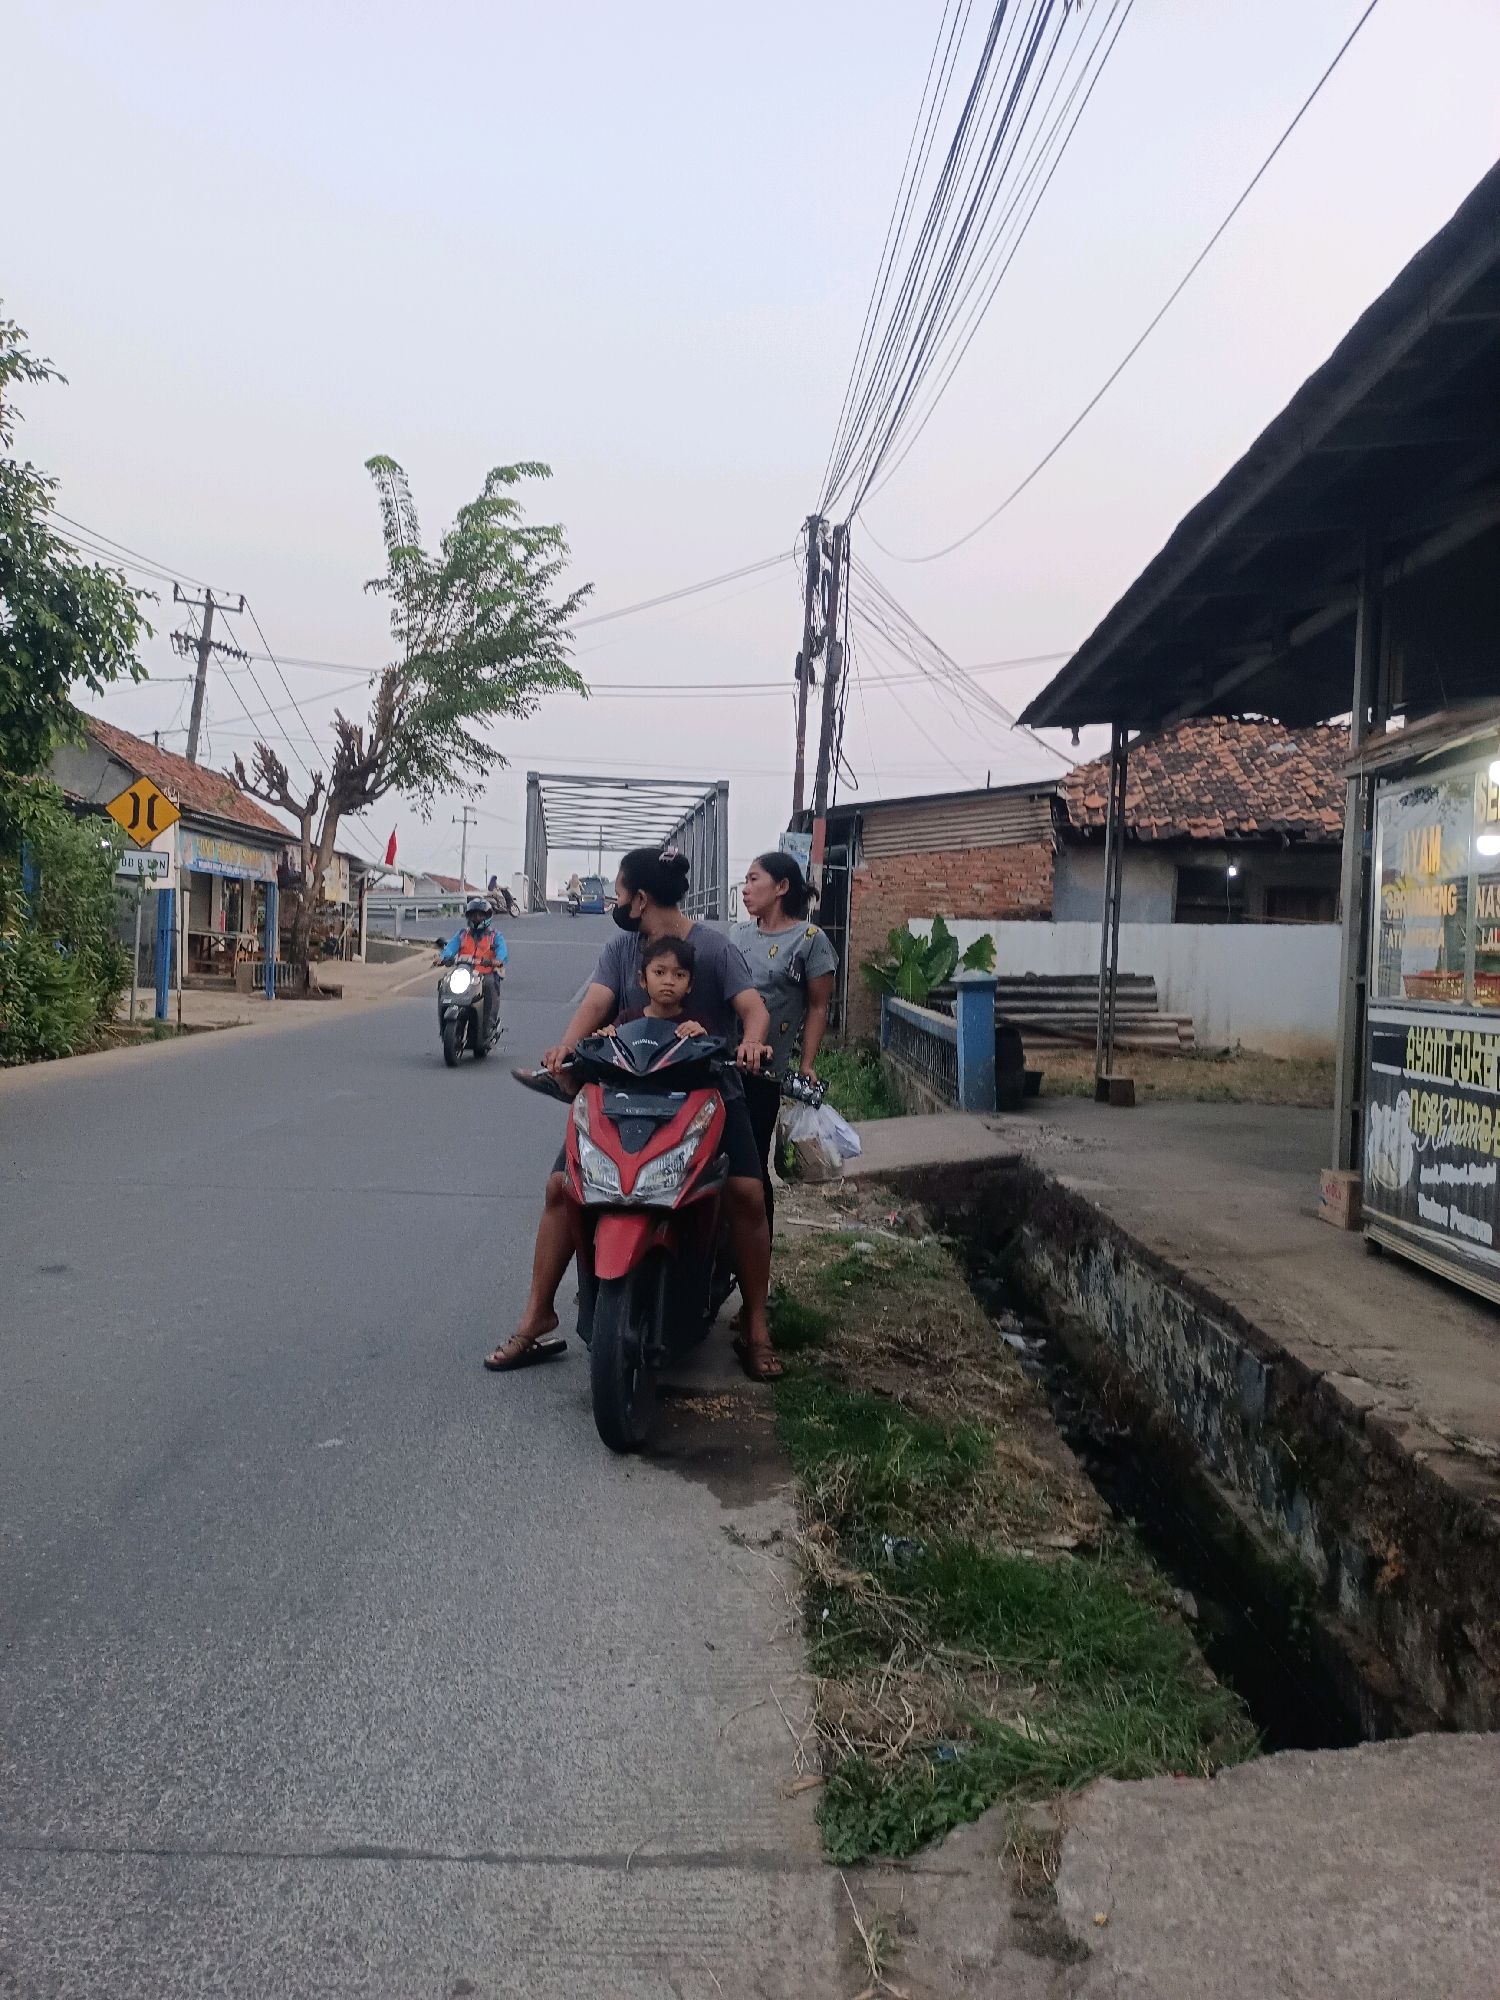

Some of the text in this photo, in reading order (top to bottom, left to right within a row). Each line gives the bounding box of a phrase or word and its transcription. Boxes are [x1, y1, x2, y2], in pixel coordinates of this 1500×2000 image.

[1401, 824, 1441, 876] AYAM
[1385, 884, 1457, 918] SERUNDENG
[1406, 1026, 1447, 1076] AYAM
